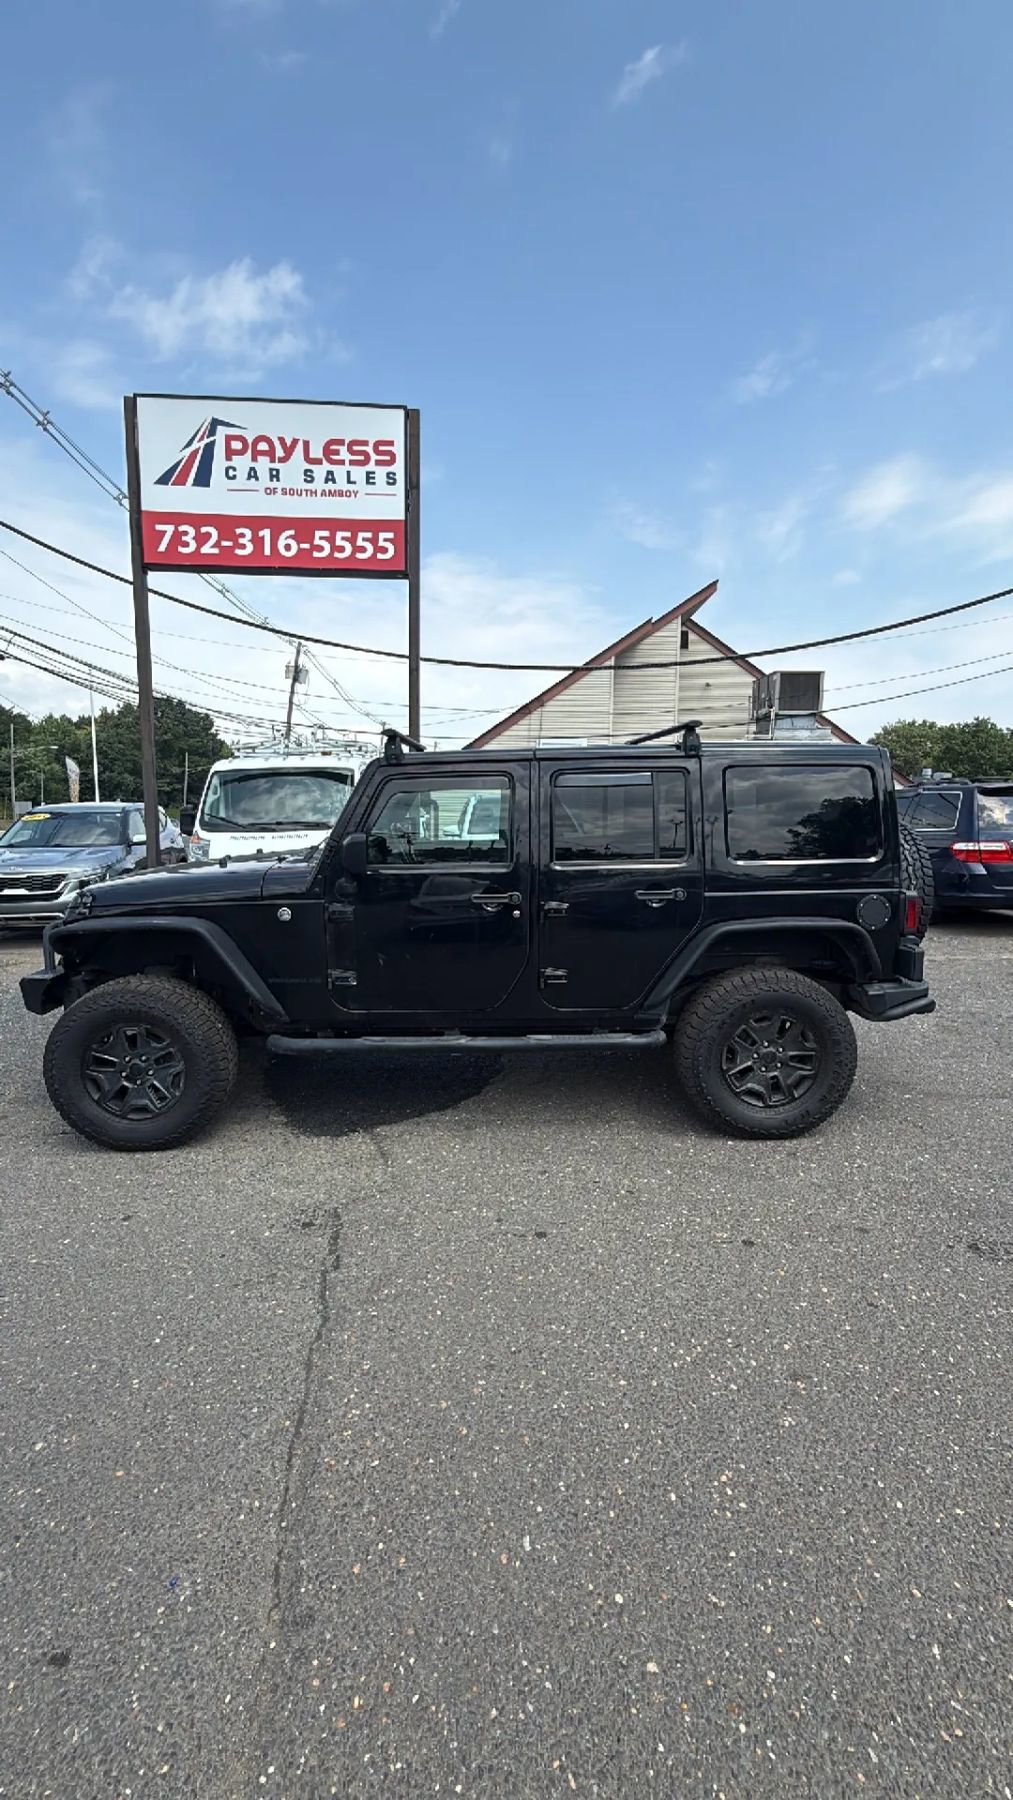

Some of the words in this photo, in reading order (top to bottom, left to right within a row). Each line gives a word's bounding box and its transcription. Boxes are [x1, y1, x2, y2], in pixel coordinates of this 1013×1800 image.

[224, 433, 397, 467] PAYLESS
[224, 465, 281, 483] CAR
[303, 468, 397, 486] SALES
[264, 487, 279, 496] OF
[281, 487, 318, 498] SOUTH
[320, 489, 359, 499] AMBOY
[154, 524, 395, 560] 732-316-5555
